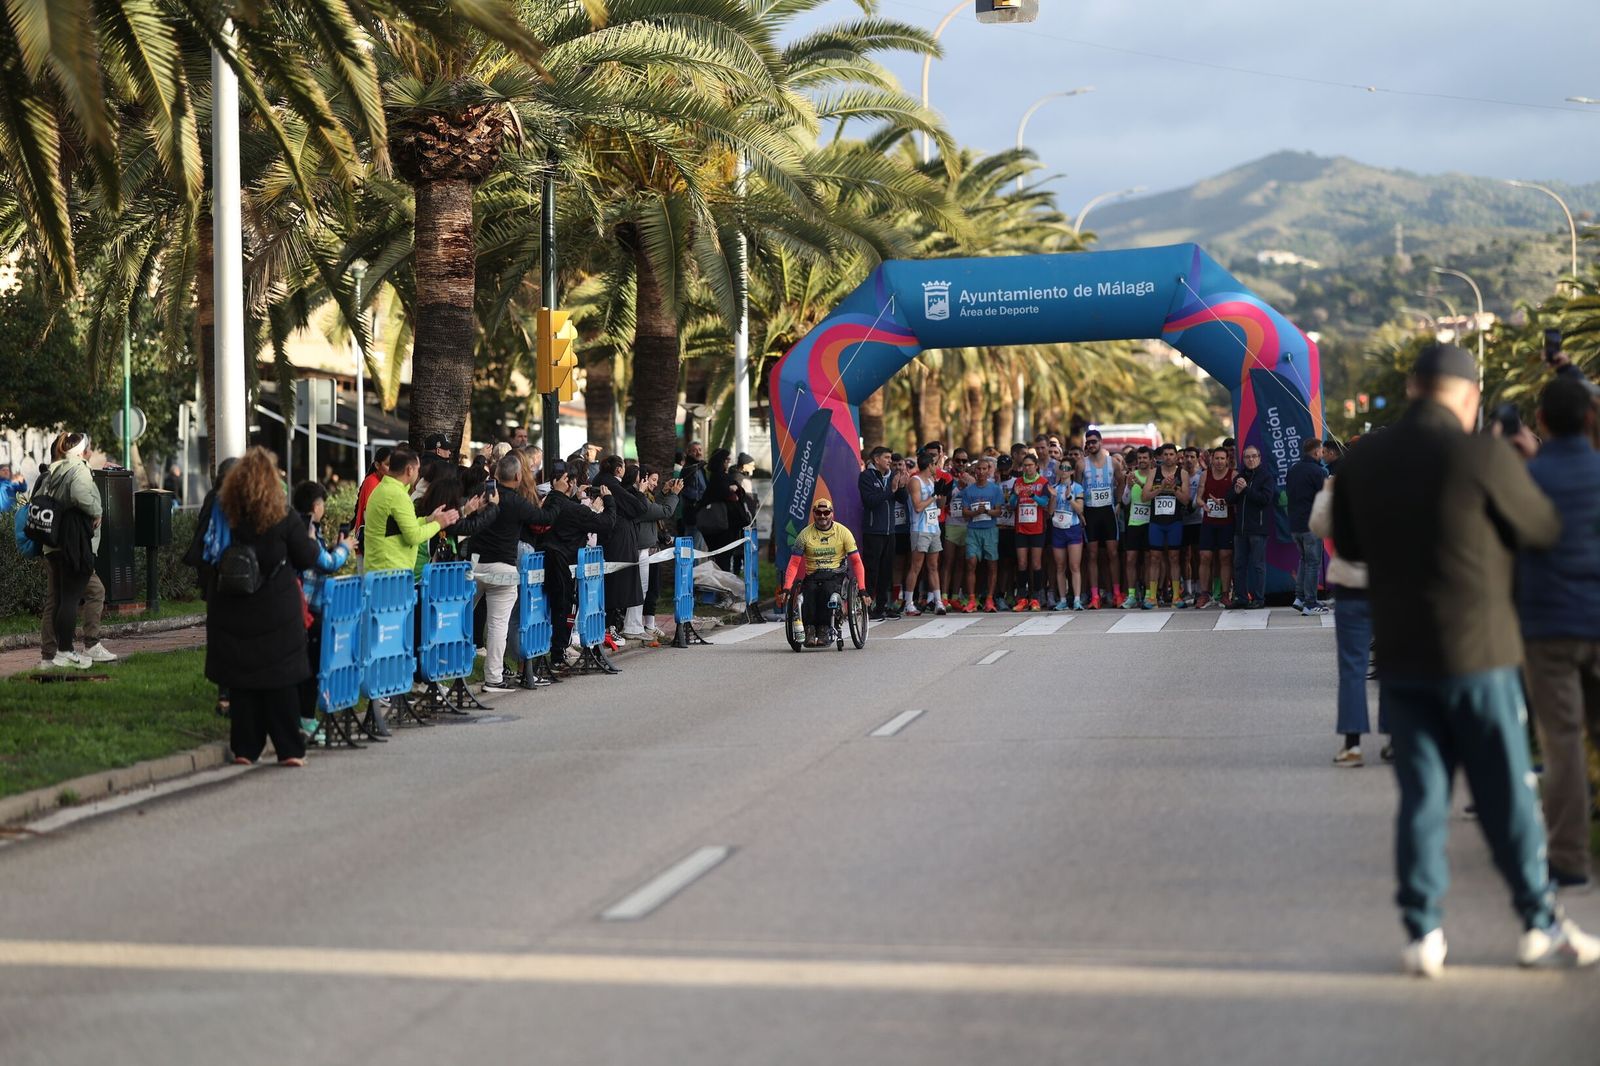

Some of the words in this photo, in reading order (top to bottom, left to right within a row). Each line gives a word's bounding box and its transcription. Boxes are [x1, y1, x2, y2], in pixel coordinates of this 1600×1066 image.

[959, 286, 1068, 306] Ayuntamiento
[1073, 284, 1092, 298] de
[1097, 280, 1154, 297] Málaga
[959, 306, 983, 317] Área
[985, 307, 998, 316] de
[999, 305, 1039, 316] Deporte
[1266, 406, 1288, 486] Fundación
[1284, 426, 1302, 467] icaja
[789, 440, 813, 517] Fundación
[795, 466, 815, 520] Unicaja
[1094, 491, 1110, 501] 369
[1157, 500, 1173, 508] 200
[1209, 503, 1225, 512] 268
[1020, 508, 1035, 516] 144
[1134, 507, 1149, 516] 262
